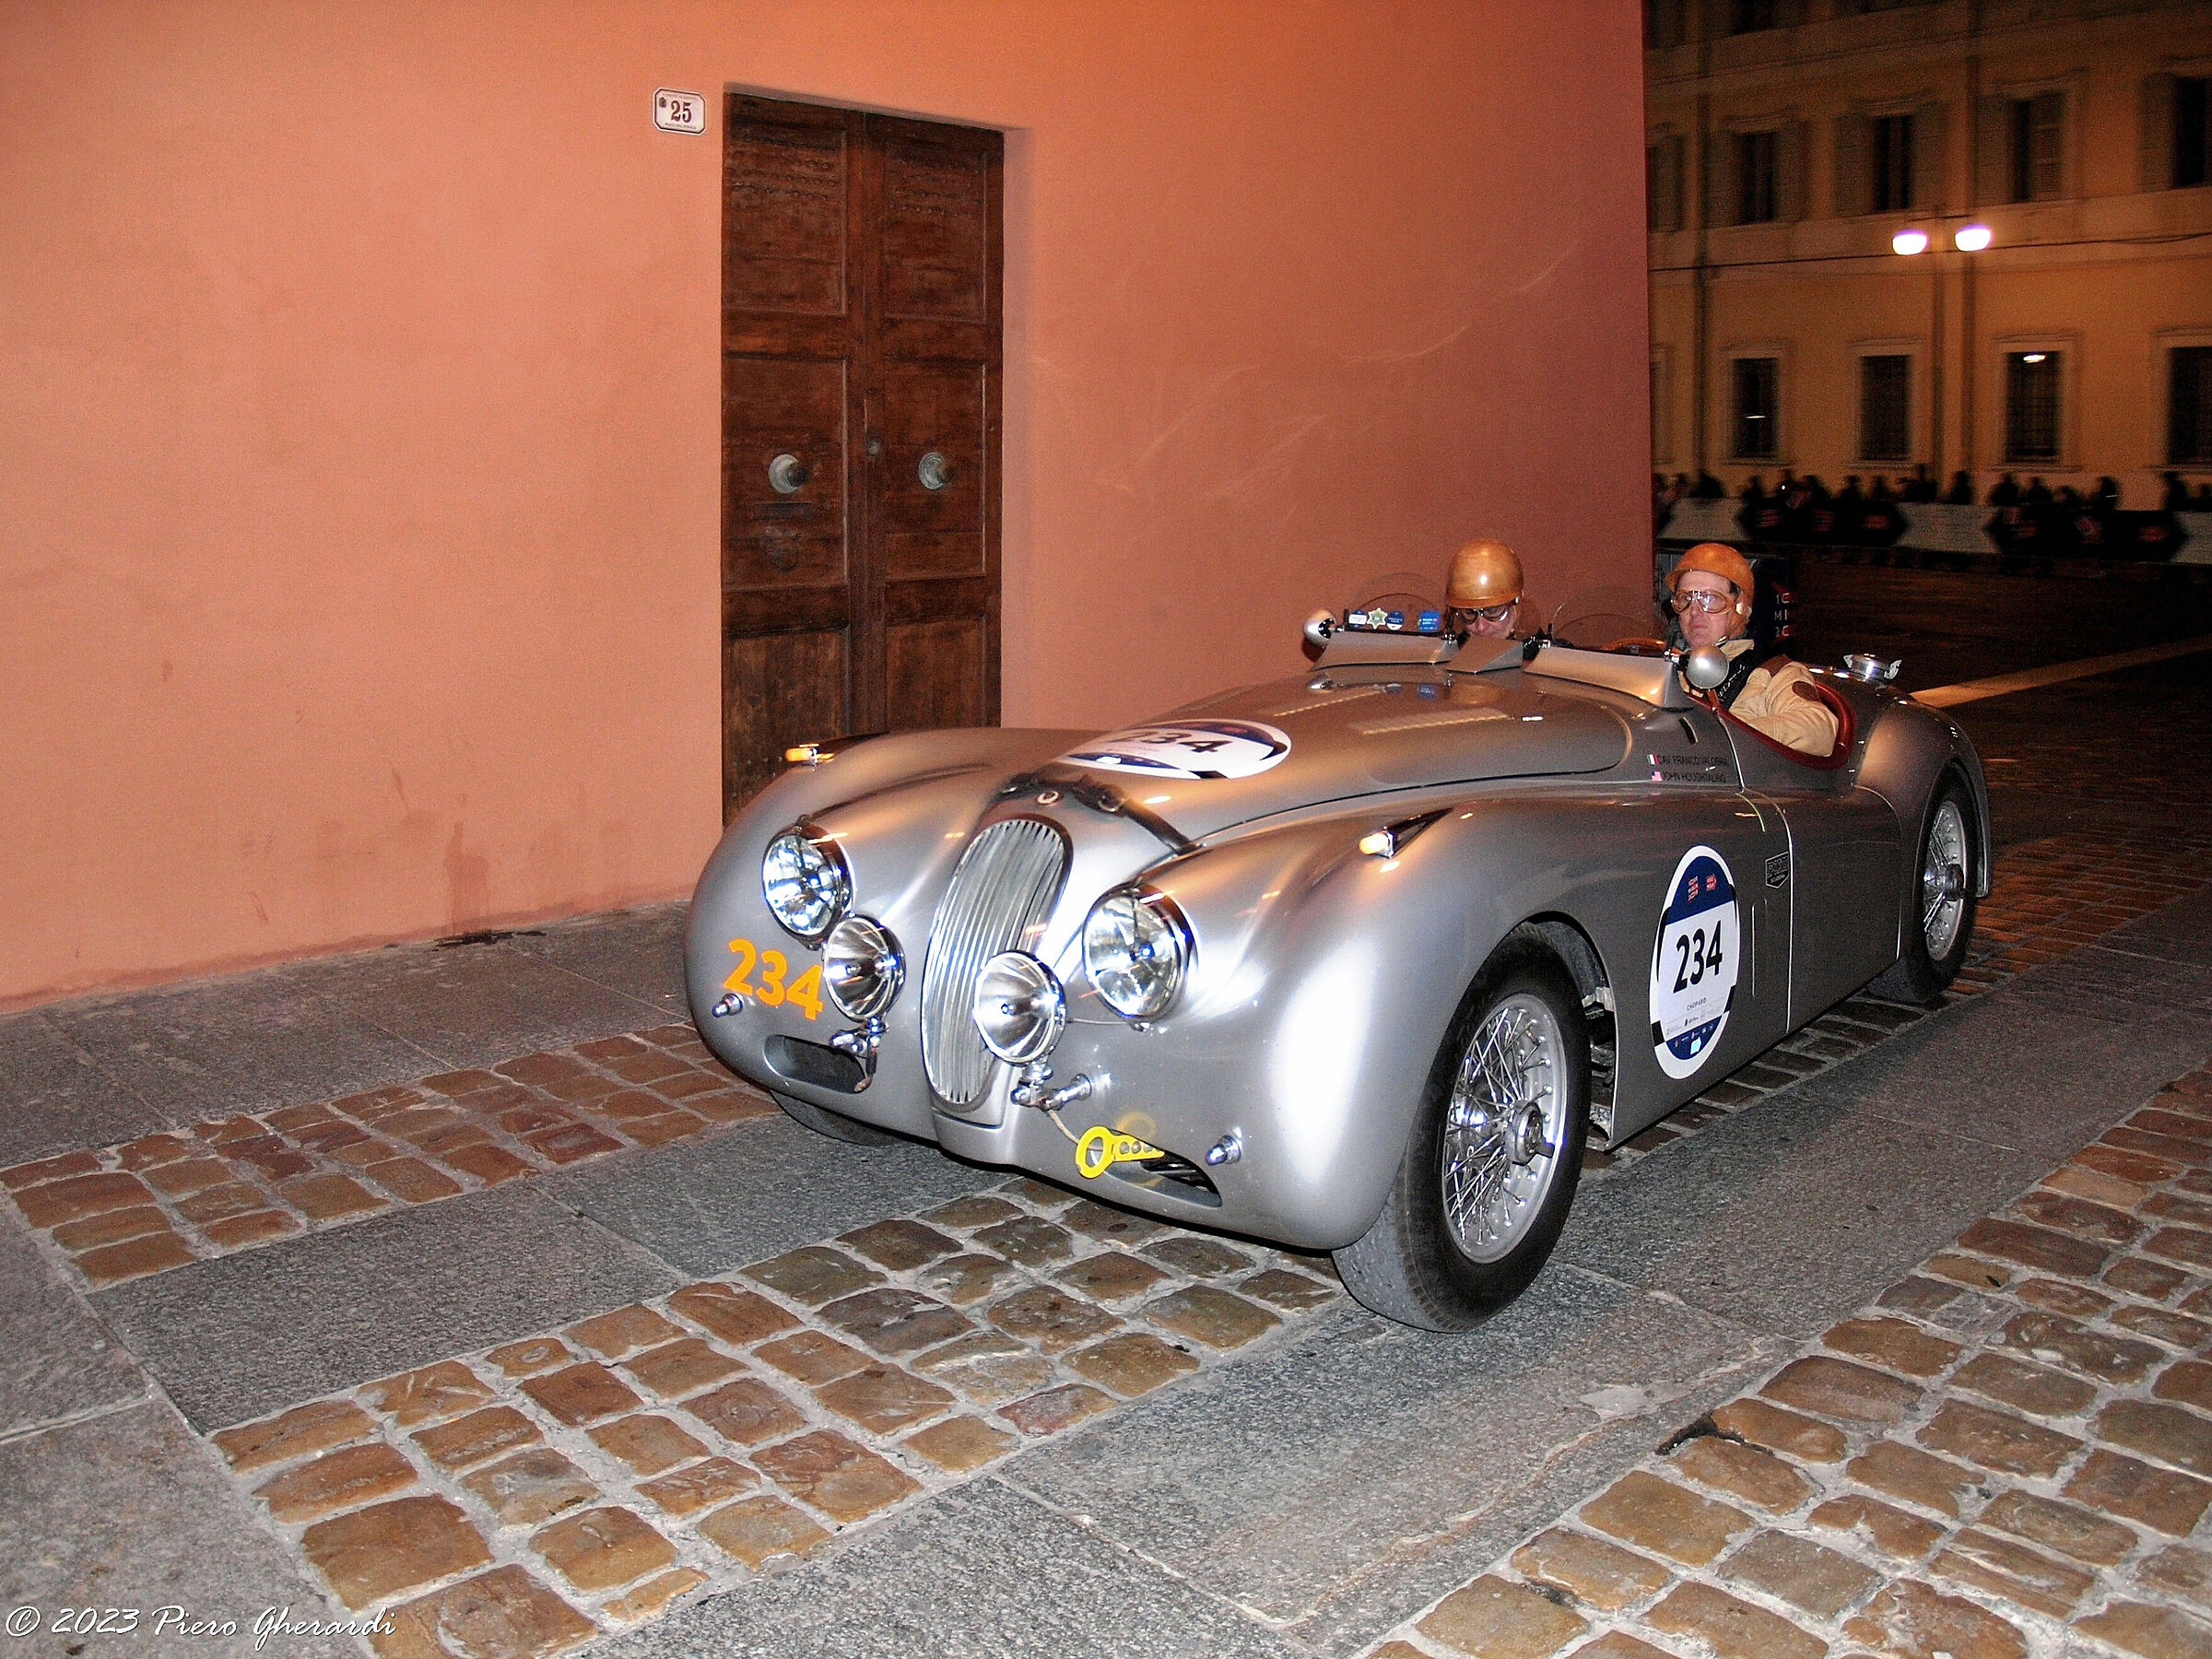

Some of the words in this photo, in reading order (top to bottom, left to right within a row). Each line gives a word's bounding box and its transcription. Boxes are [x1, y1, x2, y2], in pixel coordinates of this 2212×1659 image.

[671, 100, 692, 123] 25
[1106, 731, 1232, 753] 234
[723, 937, 824, 1021] 234
[1673, 920, 1724, 994] 234
